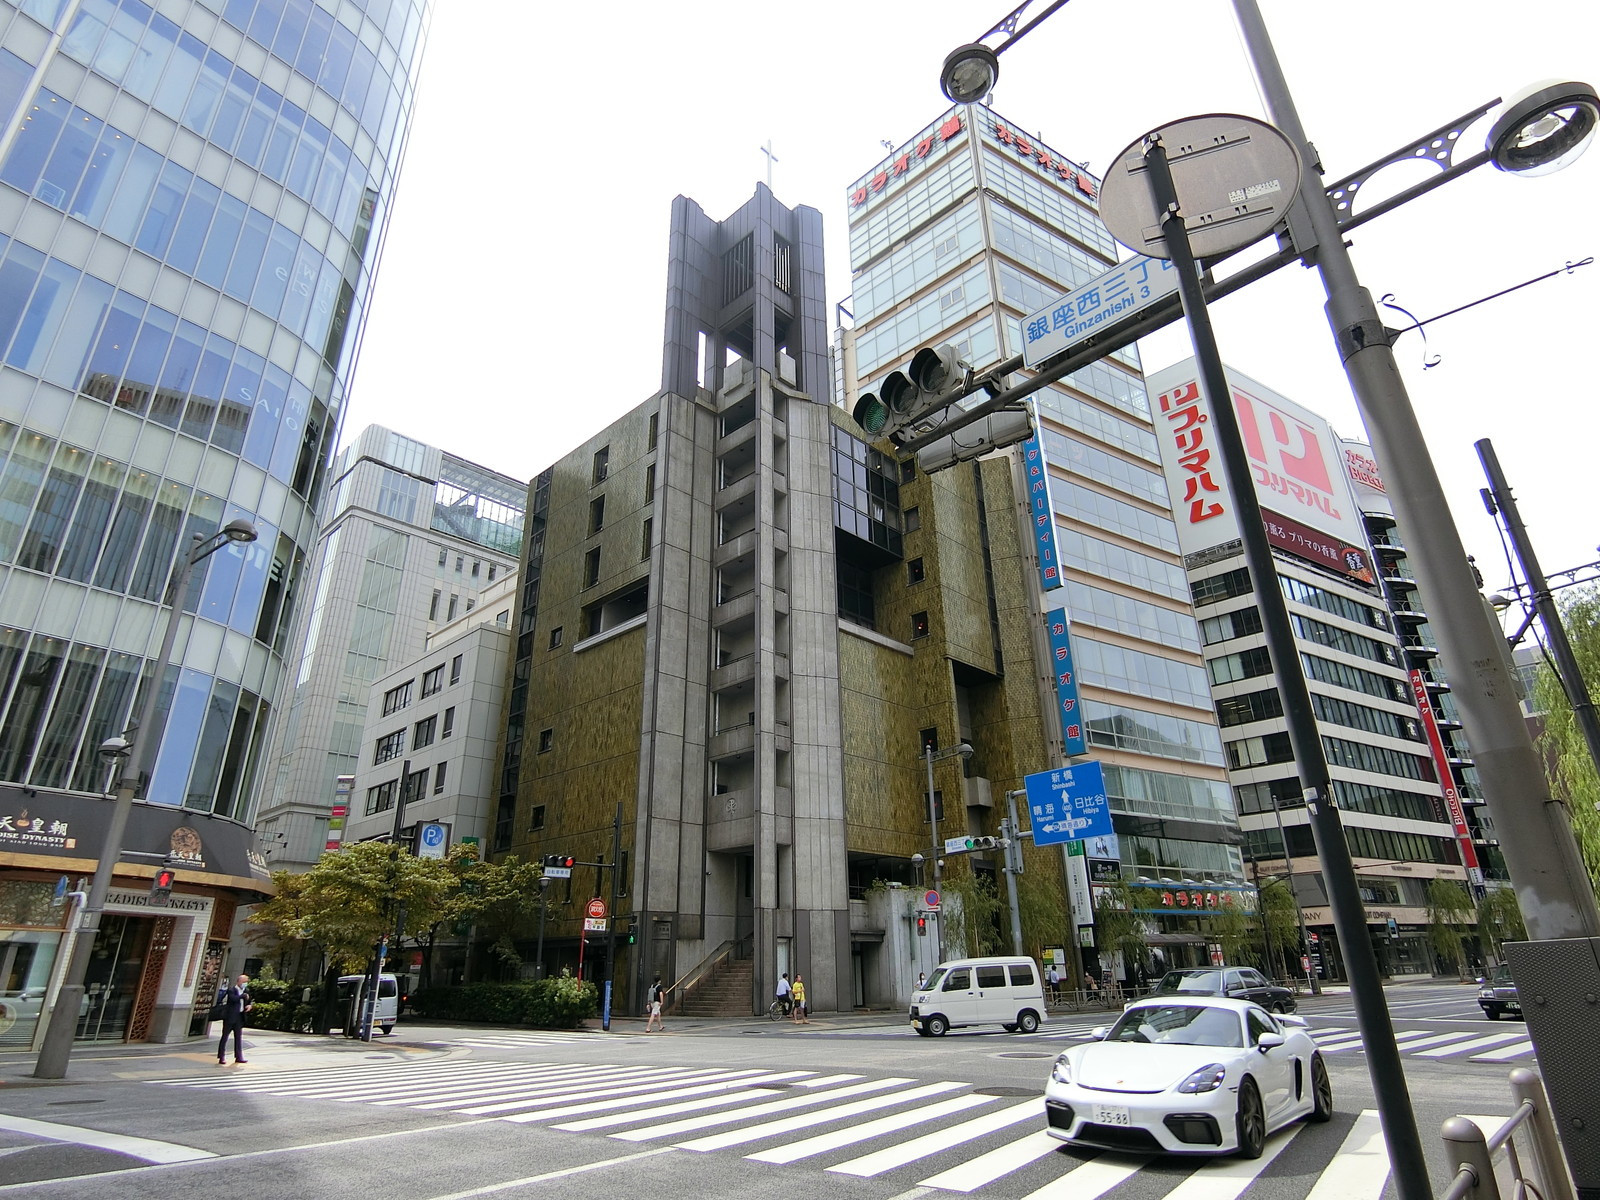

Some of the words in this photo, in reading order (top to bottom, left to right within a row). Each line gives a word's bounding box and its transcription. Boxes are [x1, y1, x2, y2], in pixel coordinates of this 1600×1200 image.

[851, 115, 963, 208] カラオケ館
[996, 123, 1099, 197] カラオケ館
[1064, 293, 1135, 339] Ginzanishi
[1140, 285, 1151, 301] 3
[1167, 404, 1225, 524] プリマハム
[1251, 463, 1342, 521] プリマハム
[1053, 622, 1080, 740] カラオケ館
[1412, 676, 1430, 714] カラオケ
[1075, 794, 1105, 809] 日比谷
[1082, 807, 1100, 815] Hibiya
[22, 833, 67, 844] DYNASTY
